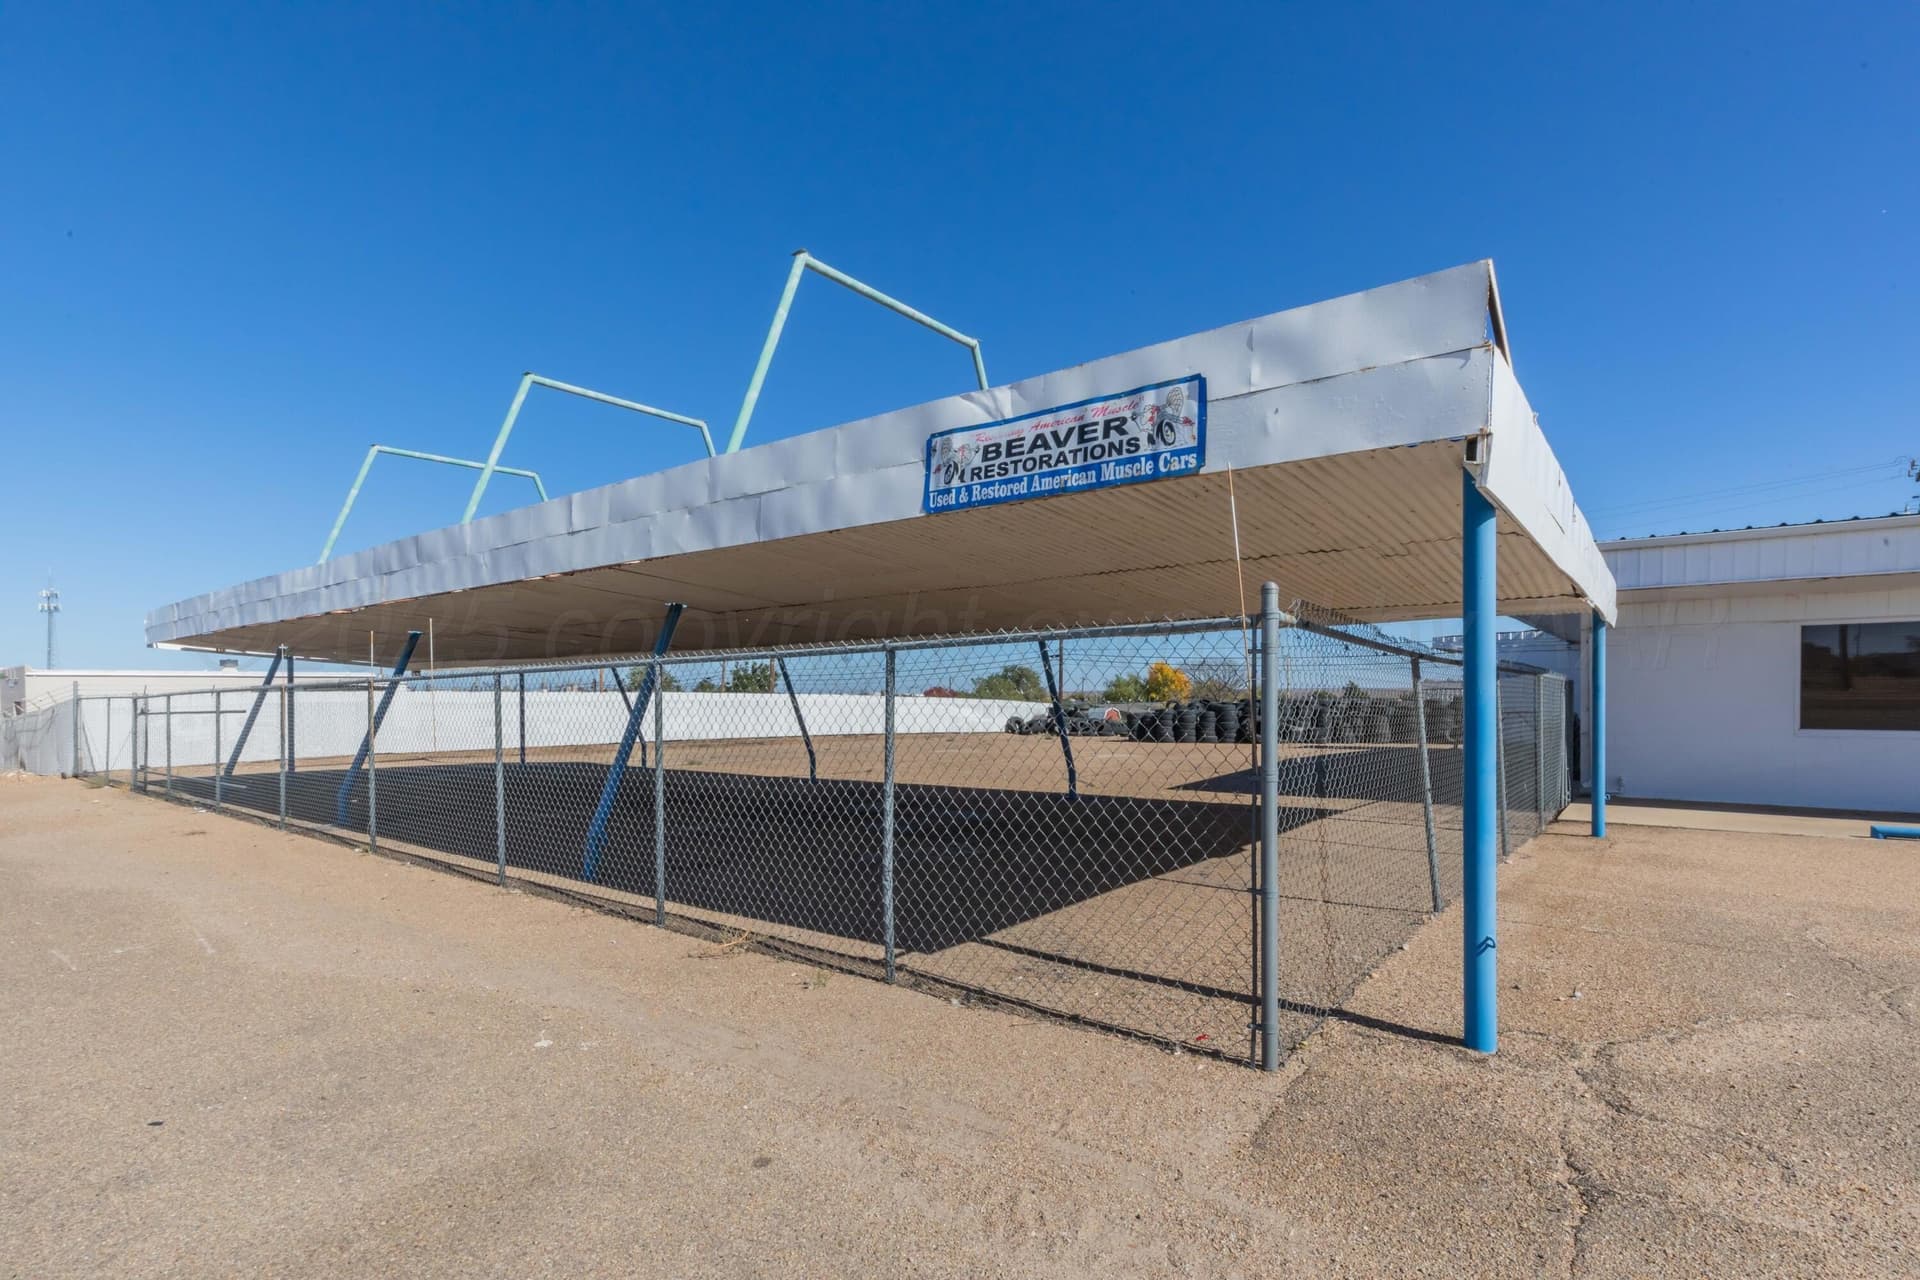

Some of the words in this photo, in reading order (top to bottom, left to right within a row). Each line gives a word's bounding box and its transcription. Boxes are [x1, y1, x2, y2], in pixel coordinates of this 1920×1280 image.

[981, 415, 1129, 462] BEAVER
[1029, 413, 1085, 432] American
[929, 489, 956, 508] Used
[959, 488, 969, 501] &
[971, 477, 1028, 501] Restored
[1030, 470, 1096, 492] American
[1100, 457, 1154, 481] Muscle
[1158, 452, 1197, 472] Cars
[970, 437, 1141, 481] RESTORATIONS
